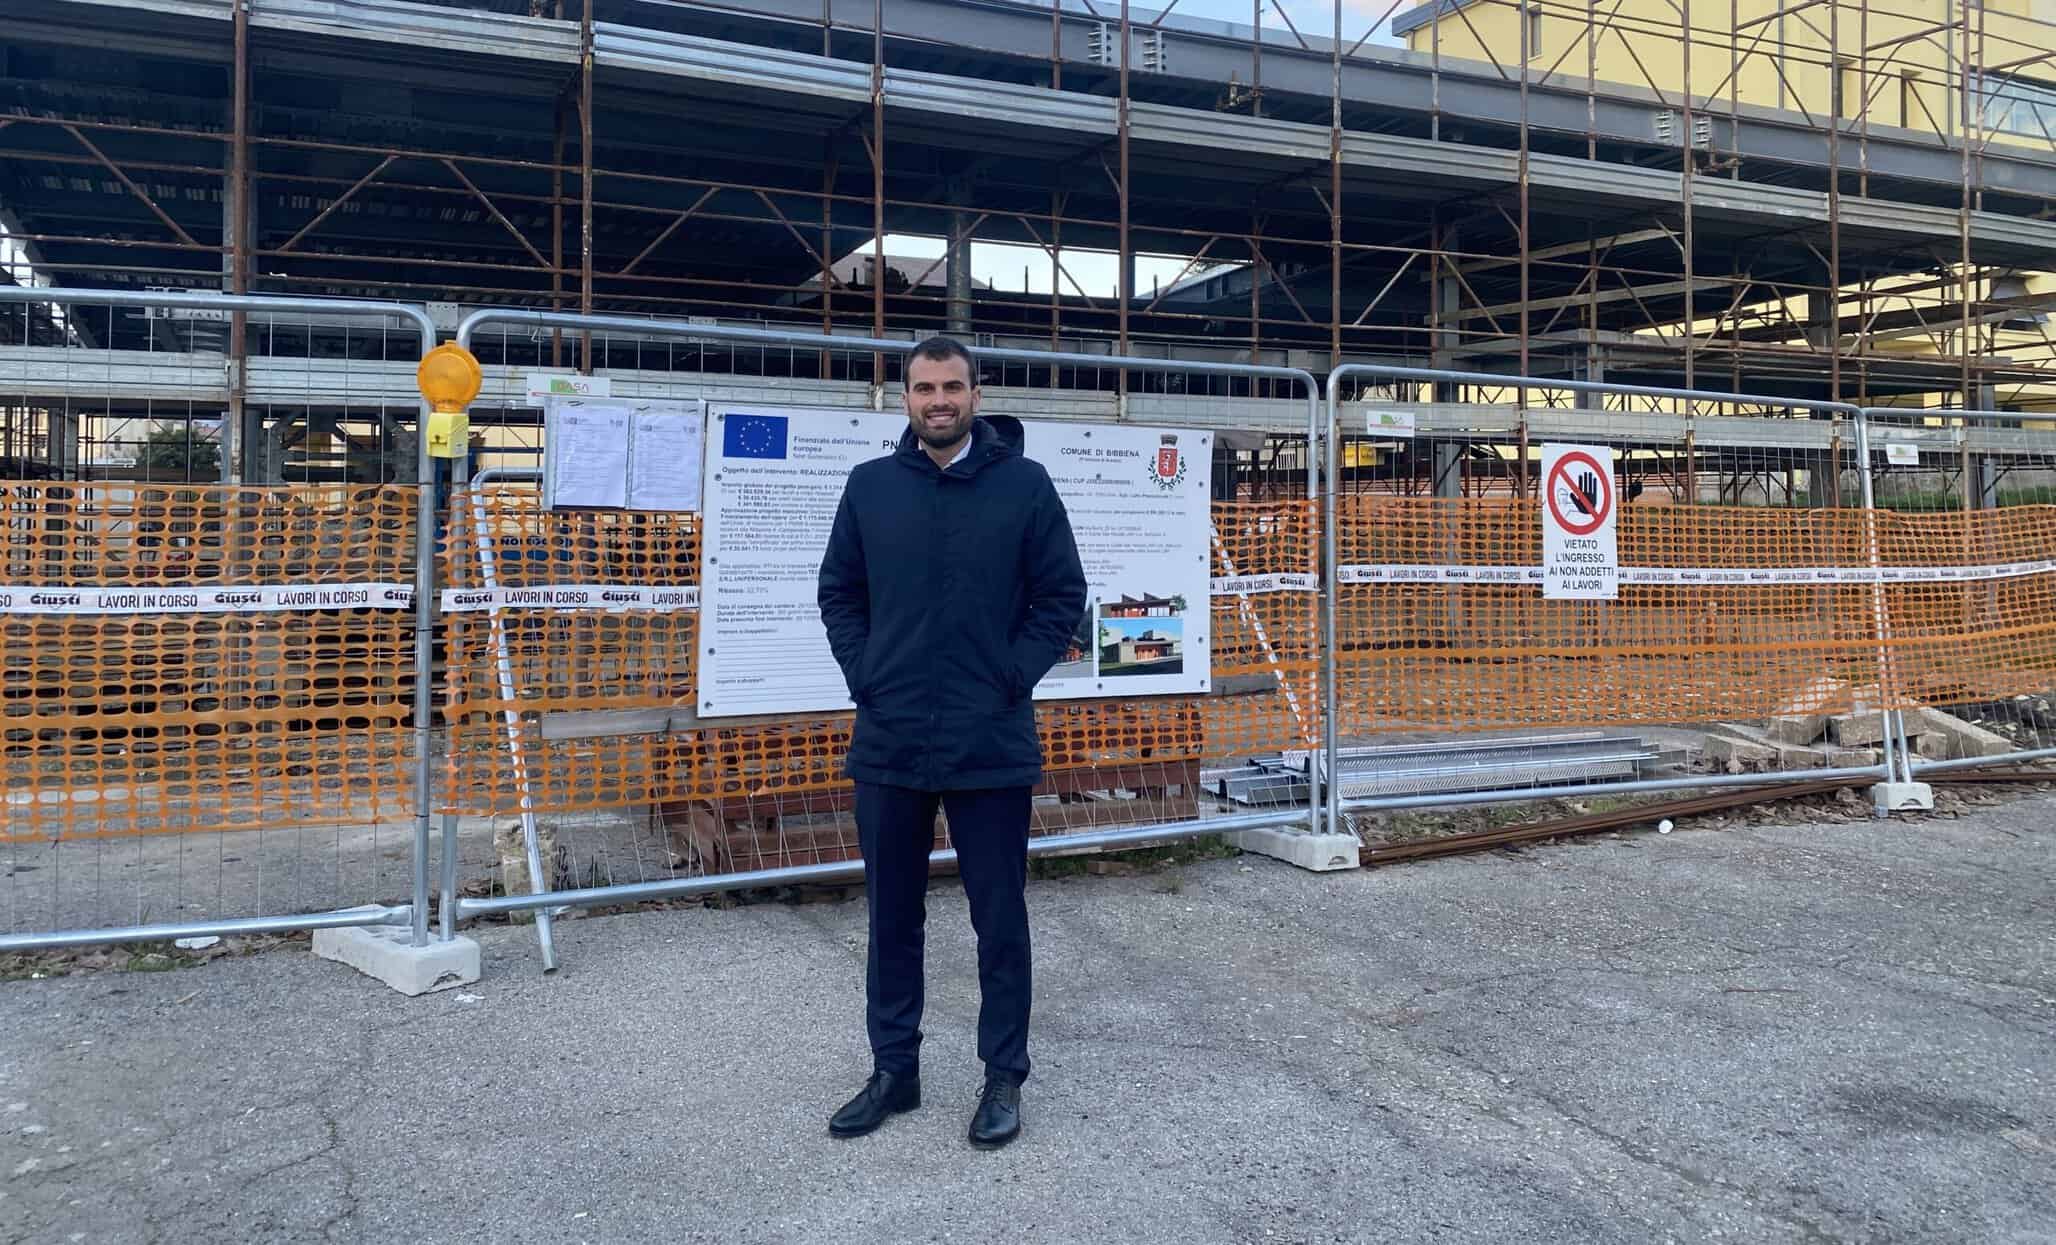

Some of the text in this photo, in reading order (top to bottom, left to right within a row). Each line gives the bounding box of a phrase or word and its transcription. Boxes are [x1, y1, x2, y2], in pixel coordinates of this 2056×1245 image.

[1061, 447, 1093, 456] COMUNE
[1106, 449, 1140, 457] BIBBIENA
[1564, 539, 1598, 549] VIETATO
[1555, 552, 1605, 563] L'INGRESSO
[1549, 566, 1614, 577] AI NON ADDETTI
[1562, 579, 1603, 590] AI LAVORI
[30, 593, 80, 606] Giusti
[98, 595, 140, 608] LAVORI
[143, 595, 156, 608] IN
[159, 594, 198, 607] CORSO
[214, 592, 262, 604] Giusti
[277, 592, 316, 606] LAVORI
[319, 592, 330, 605] IN
[333, 590, 368, 604] CORSO
[454, 591, 695, 605] Giusti LAVORI IN CORSO Giusti LAVORI IN
